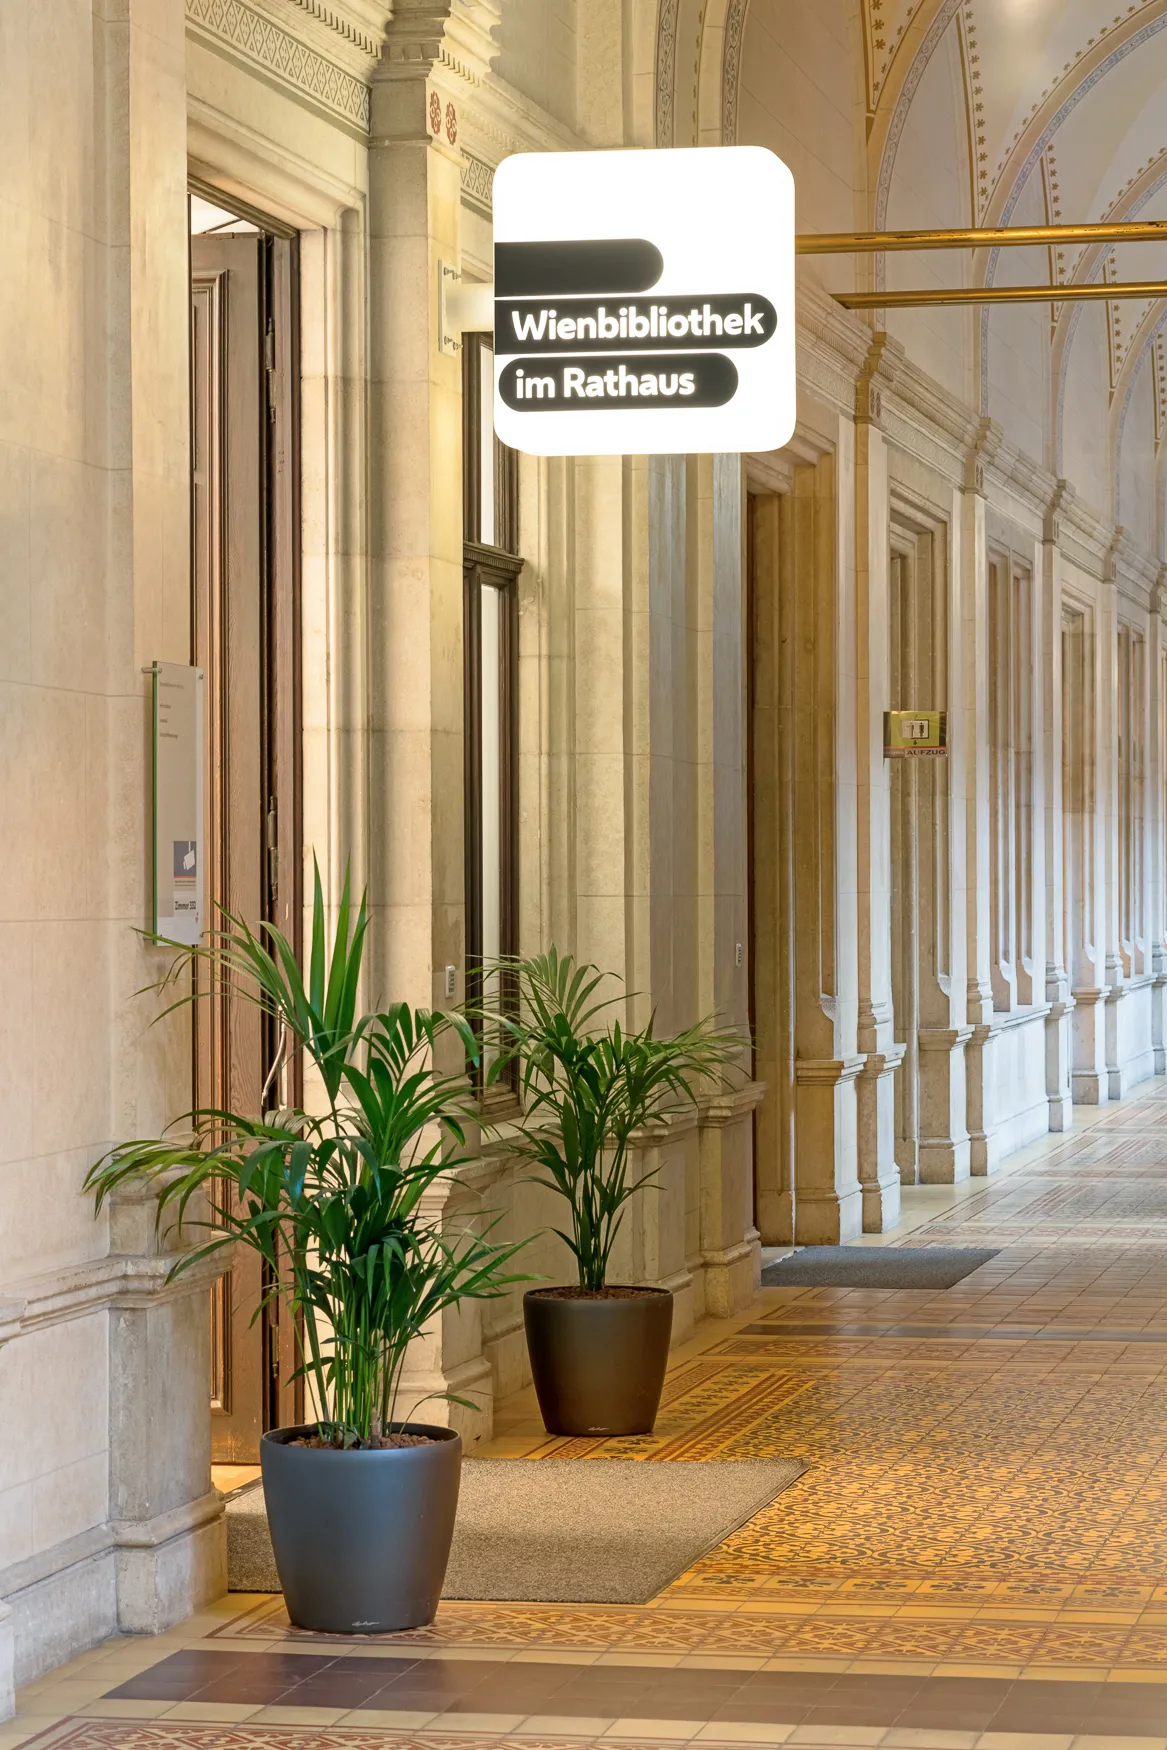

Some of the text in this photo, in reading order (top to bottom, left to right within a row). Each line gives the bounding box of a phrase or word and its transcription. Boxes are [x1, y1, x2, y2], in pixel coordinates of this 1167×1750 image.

[511, 303, 765, 341] Wienbibliothek
[515, 365, 696, 399] im Rathaus
